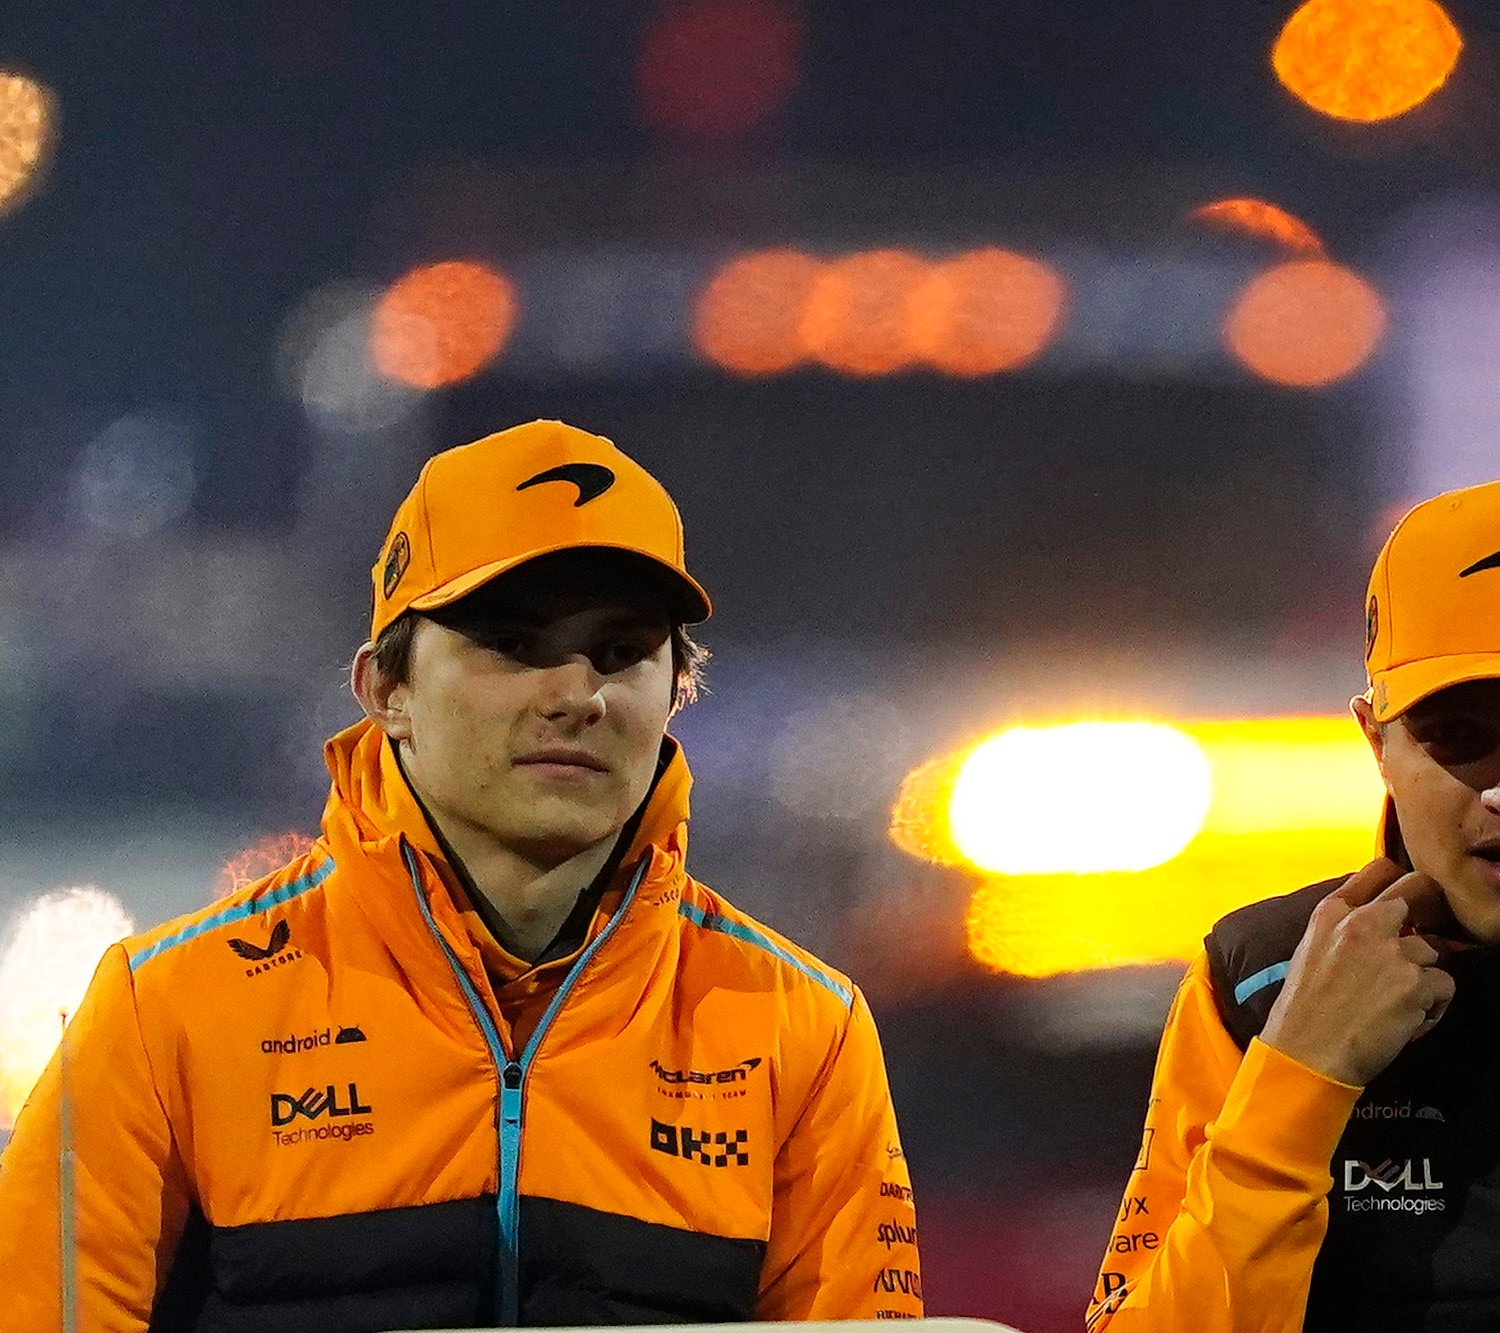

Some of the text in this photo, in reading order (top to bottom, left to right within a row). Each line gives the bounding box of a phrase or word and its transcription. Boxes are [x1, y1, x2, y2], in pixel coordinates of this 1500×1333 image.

[261, 1028, 331, 1054] android
[270, 1082, 372, 1127] DELL
[272, 1121, 375, 1147] Technologies
[650, 1116, 749, 1168] OKX
[1344, 1158, 1444, 1192] DELL
[1344, 1195, 1446, 1215] Technologies
